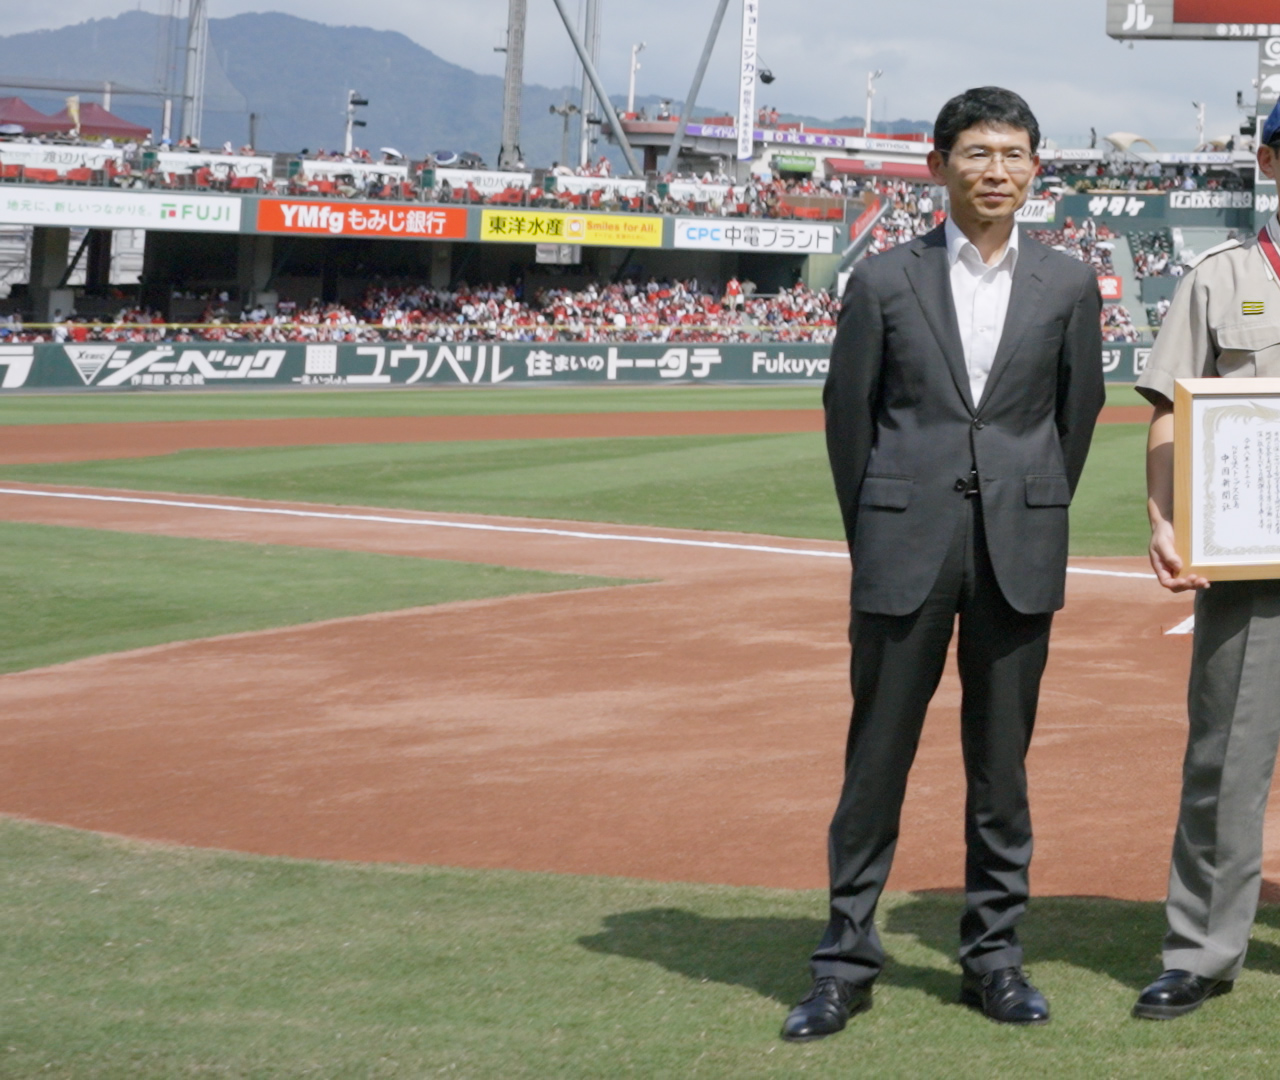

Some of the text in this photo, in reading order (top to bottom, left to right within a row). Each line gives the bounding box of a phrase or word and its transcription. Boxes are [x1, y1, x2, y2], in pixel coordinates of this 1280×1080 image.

[182, 205, 231, 221] FUJI
[1088, 196, 1145, 216] サタケ
[280, 204, 447, 235] YMfg もみじ銀行
[489, 216, 564, 236] 東洋水産
[587, 221, 620, 232] Smiles
[624, 223, 638, 232] for
[686, 225, 830, 248] CPC 中電プラント
[97, 345, 286, 386] ジーベック
[347, 344, 514, 385] ユウベル
